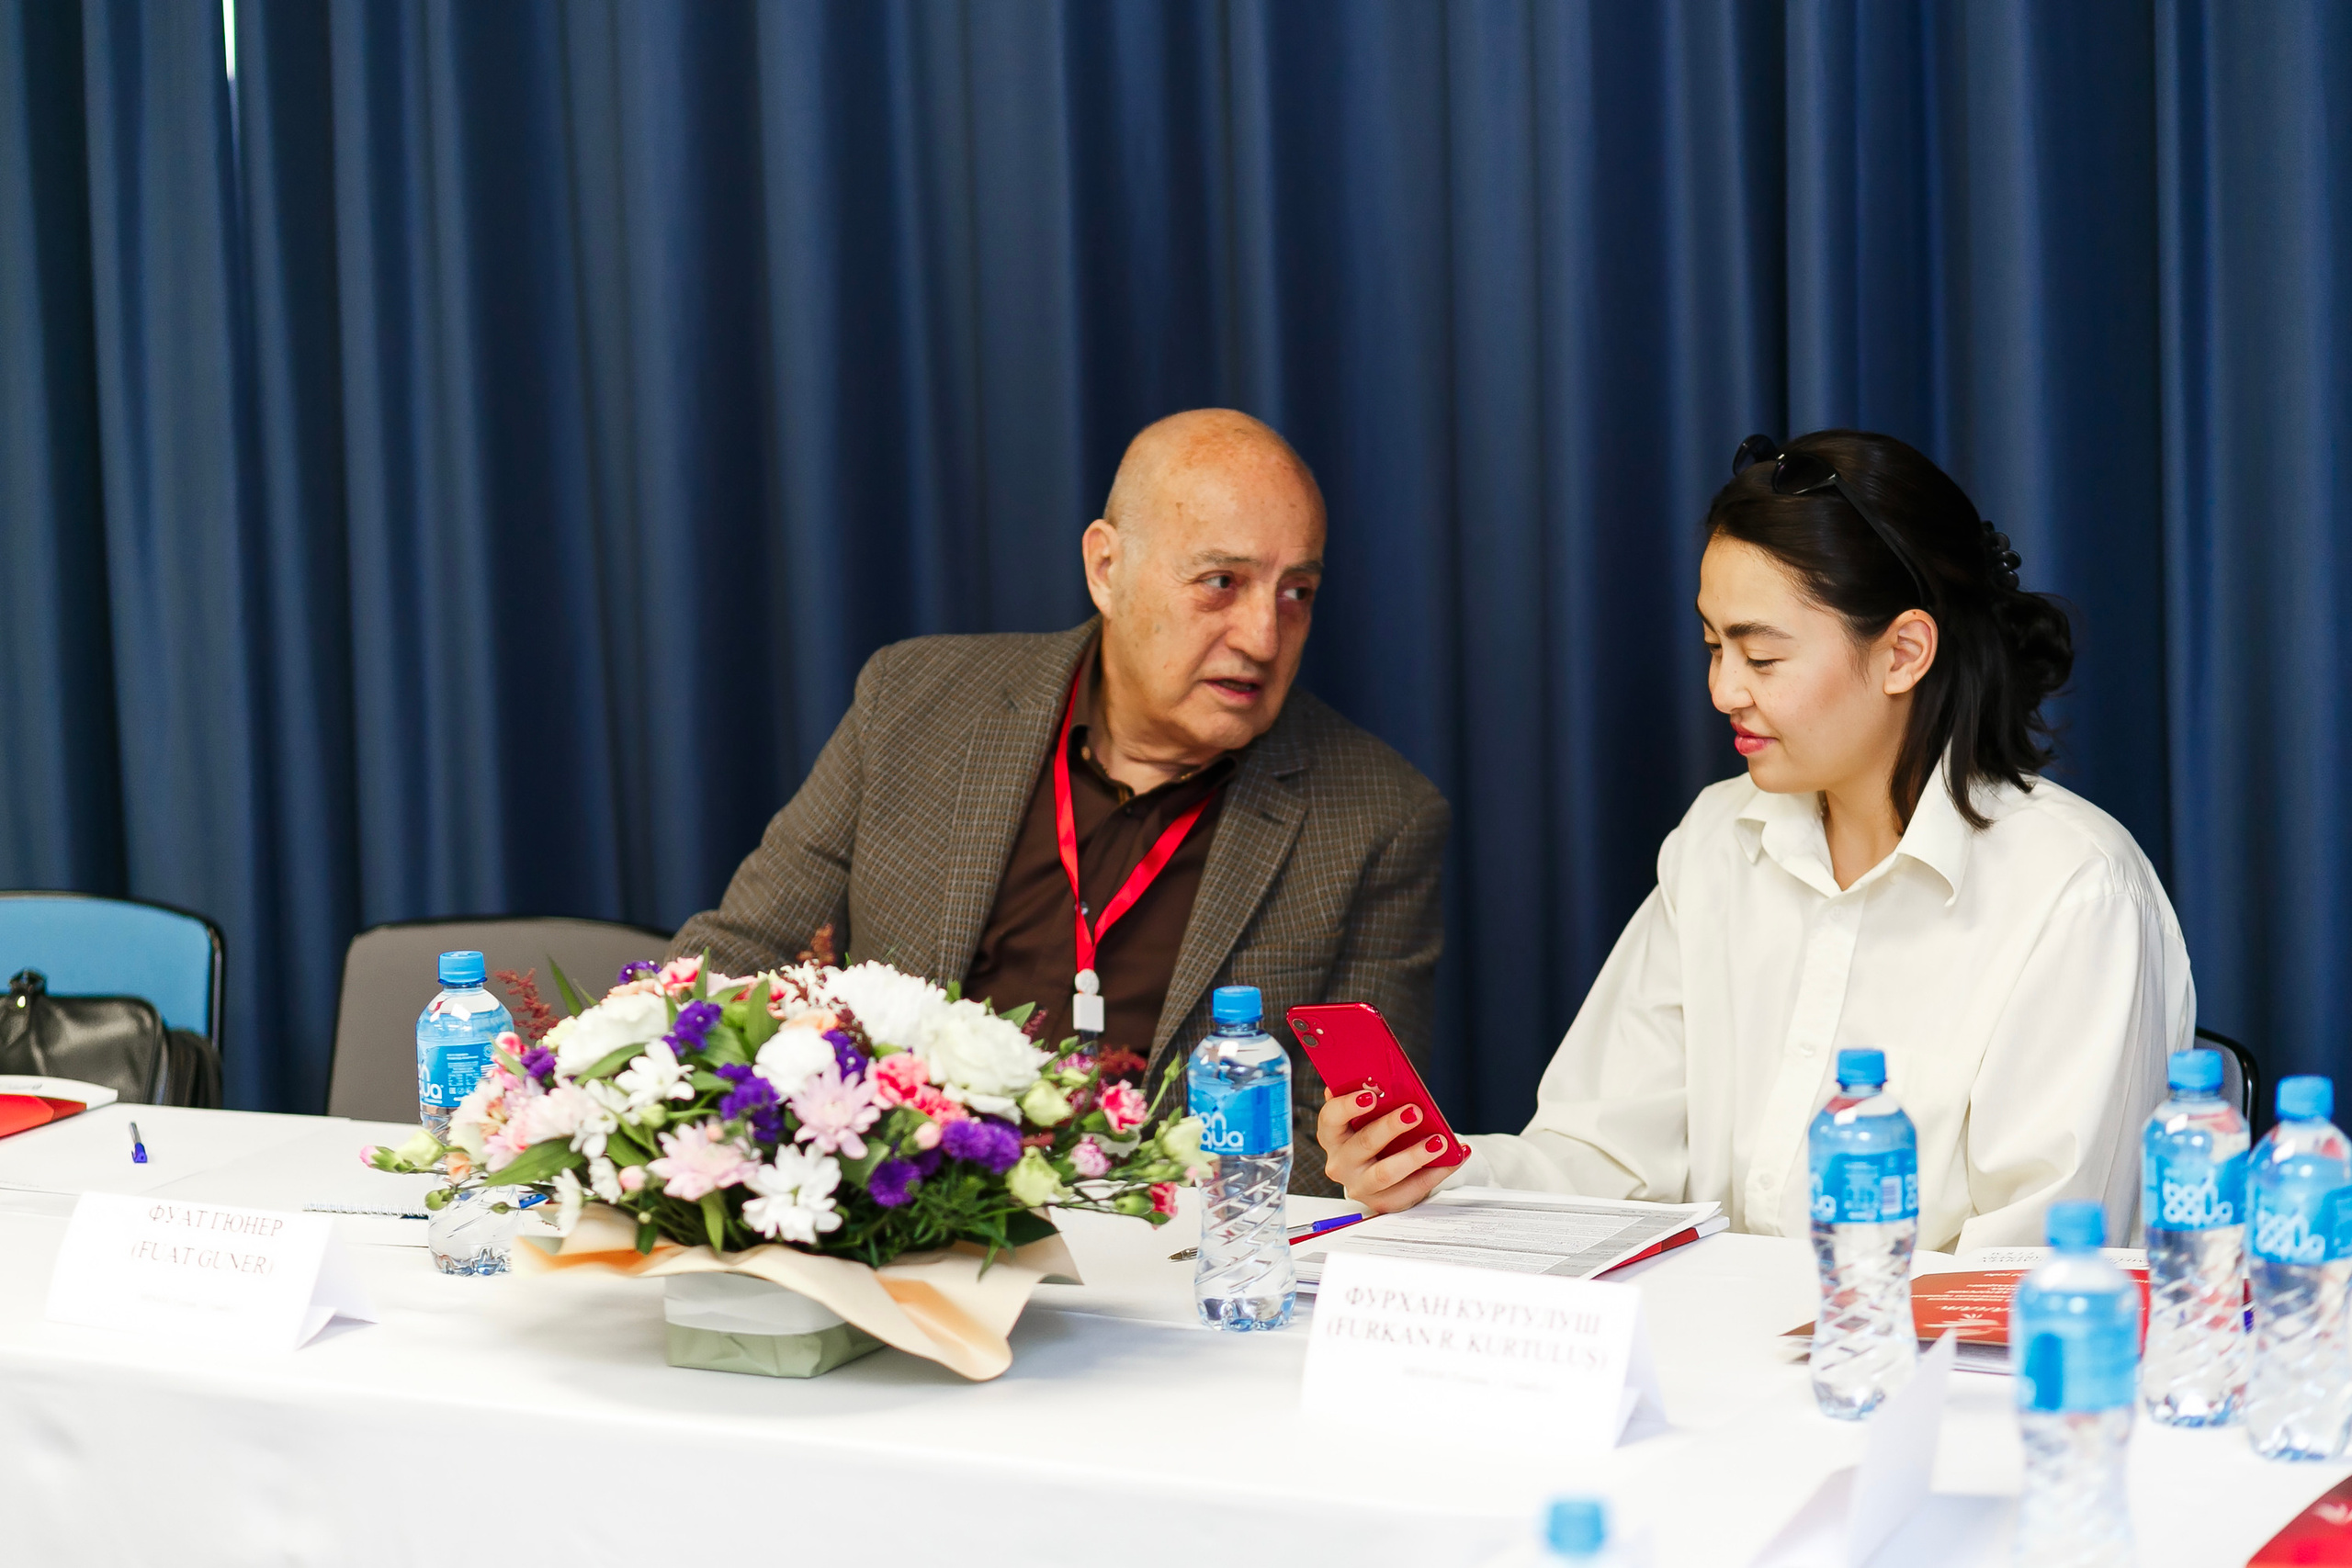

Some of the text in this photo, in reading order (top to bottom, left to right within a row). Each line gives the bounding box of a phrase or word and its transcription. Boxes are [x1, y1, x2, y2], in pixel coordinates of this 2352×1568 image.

[1200, 1130, 1245, 1149] qua
[149, 1204, 283, 1237] ФУАТ ГЮНЕР
[1344, 1286, 1601, 1336] ФУРХАН КУРТУЛУШ
[1327, 1315, 1433, 1347] (FURKAN
